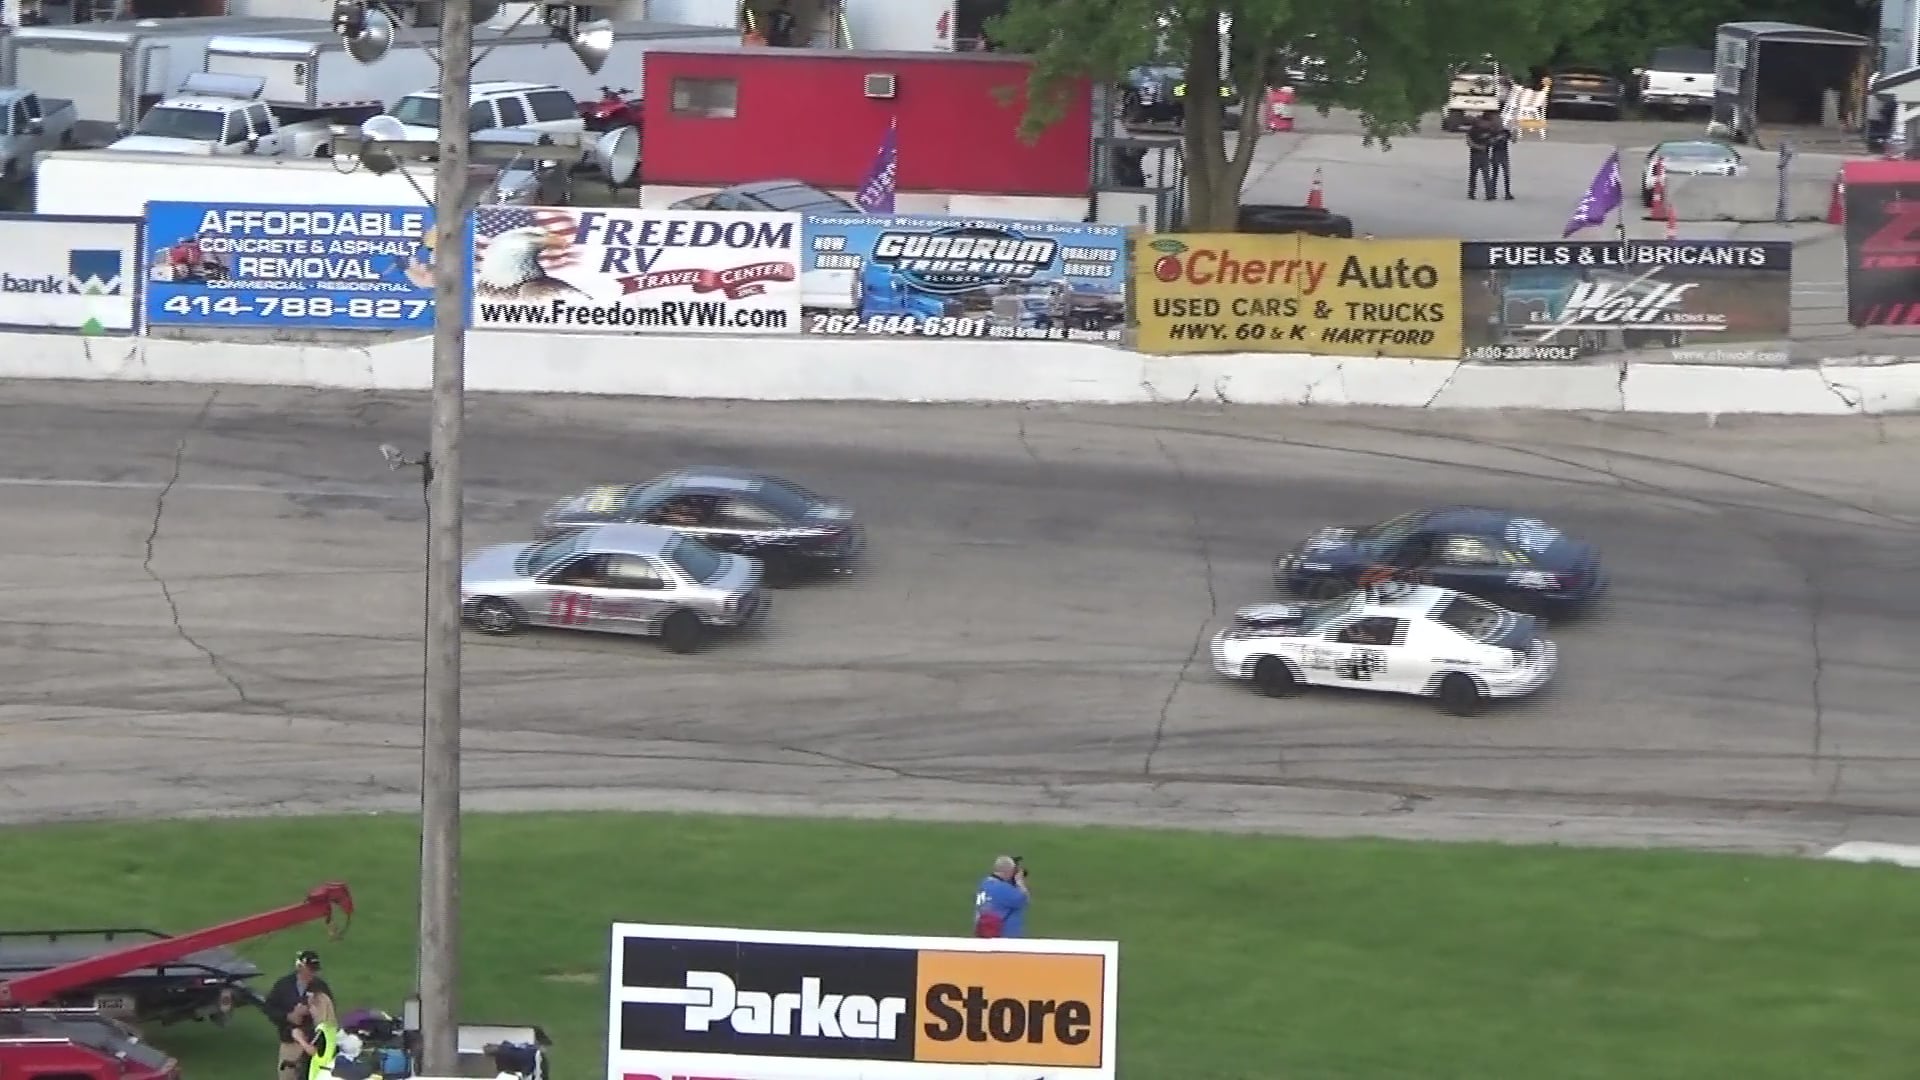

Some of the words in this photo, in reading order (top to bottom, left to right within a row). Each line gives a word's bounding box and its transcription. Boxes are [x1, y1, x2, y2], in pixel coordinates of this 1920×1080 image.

[199, 210, 423, 237] AFFORDABLE
[573, 212, 794, 248] FREEDOM
[808, 215, 892, 227] Transporting
[200, 238, 305, 254] CONCRETE
[311, 240, 323, 254] &
[329, 240, 420, 257] ASPHALT
[813, 236, 846, 250] NOW
[876, 235, 1055, 263] GUNDRUM
[600, 247, 664, 273] RV
[815, 254, 861, 269] HIRING
[1063, 248, 1117, 262] QUALIFIED
[1489, 247, 1570, 265] FUELS
[1576, 247, 1595, 265] &
[1602, 246, 1766, 266] LUBRICANTS
[238, 256, 381, 280] REMOVAL
[636, 271, 701, 290] TRAVEL
[720, 264, 785, 285] CENTER
[899, 258, 1035, 276] TRUCKING
[1064, 263, 1112, 277] DRIVERS
[1185, 249, 1327, 295] Cherry
[1337, 255, 1438, 289] Auto
[3, 272, 62, 294] bank
[207, 279, 306, 291] COMMERCIAL
[316, 281, 412, 292] RESIDENTIAL
[480, 301, 787, 327] www.FreedomRVWI.com
[1153, 298, 1220, 317] USED
[1231, 298, 1298, 317] CARS
[1313, 300, 1332, 319] &
[1345, 302, 1444, 322] TRUCKS
[1556, 282, 1699, 324] Wolf
[810, 315, 986, 337] 262-644-6301
[1169, 323, 1227, 340] HWY.
[1235, 323, 1265, 340] 60
[1270, 327, 1285, 339] &
[1289, 324, 1307, 340] K
[1321, 326, 1434, 345] HARTFORD
[685, 971, 905, 1041] Parker
[924, 983, 1090, 1045] Store
